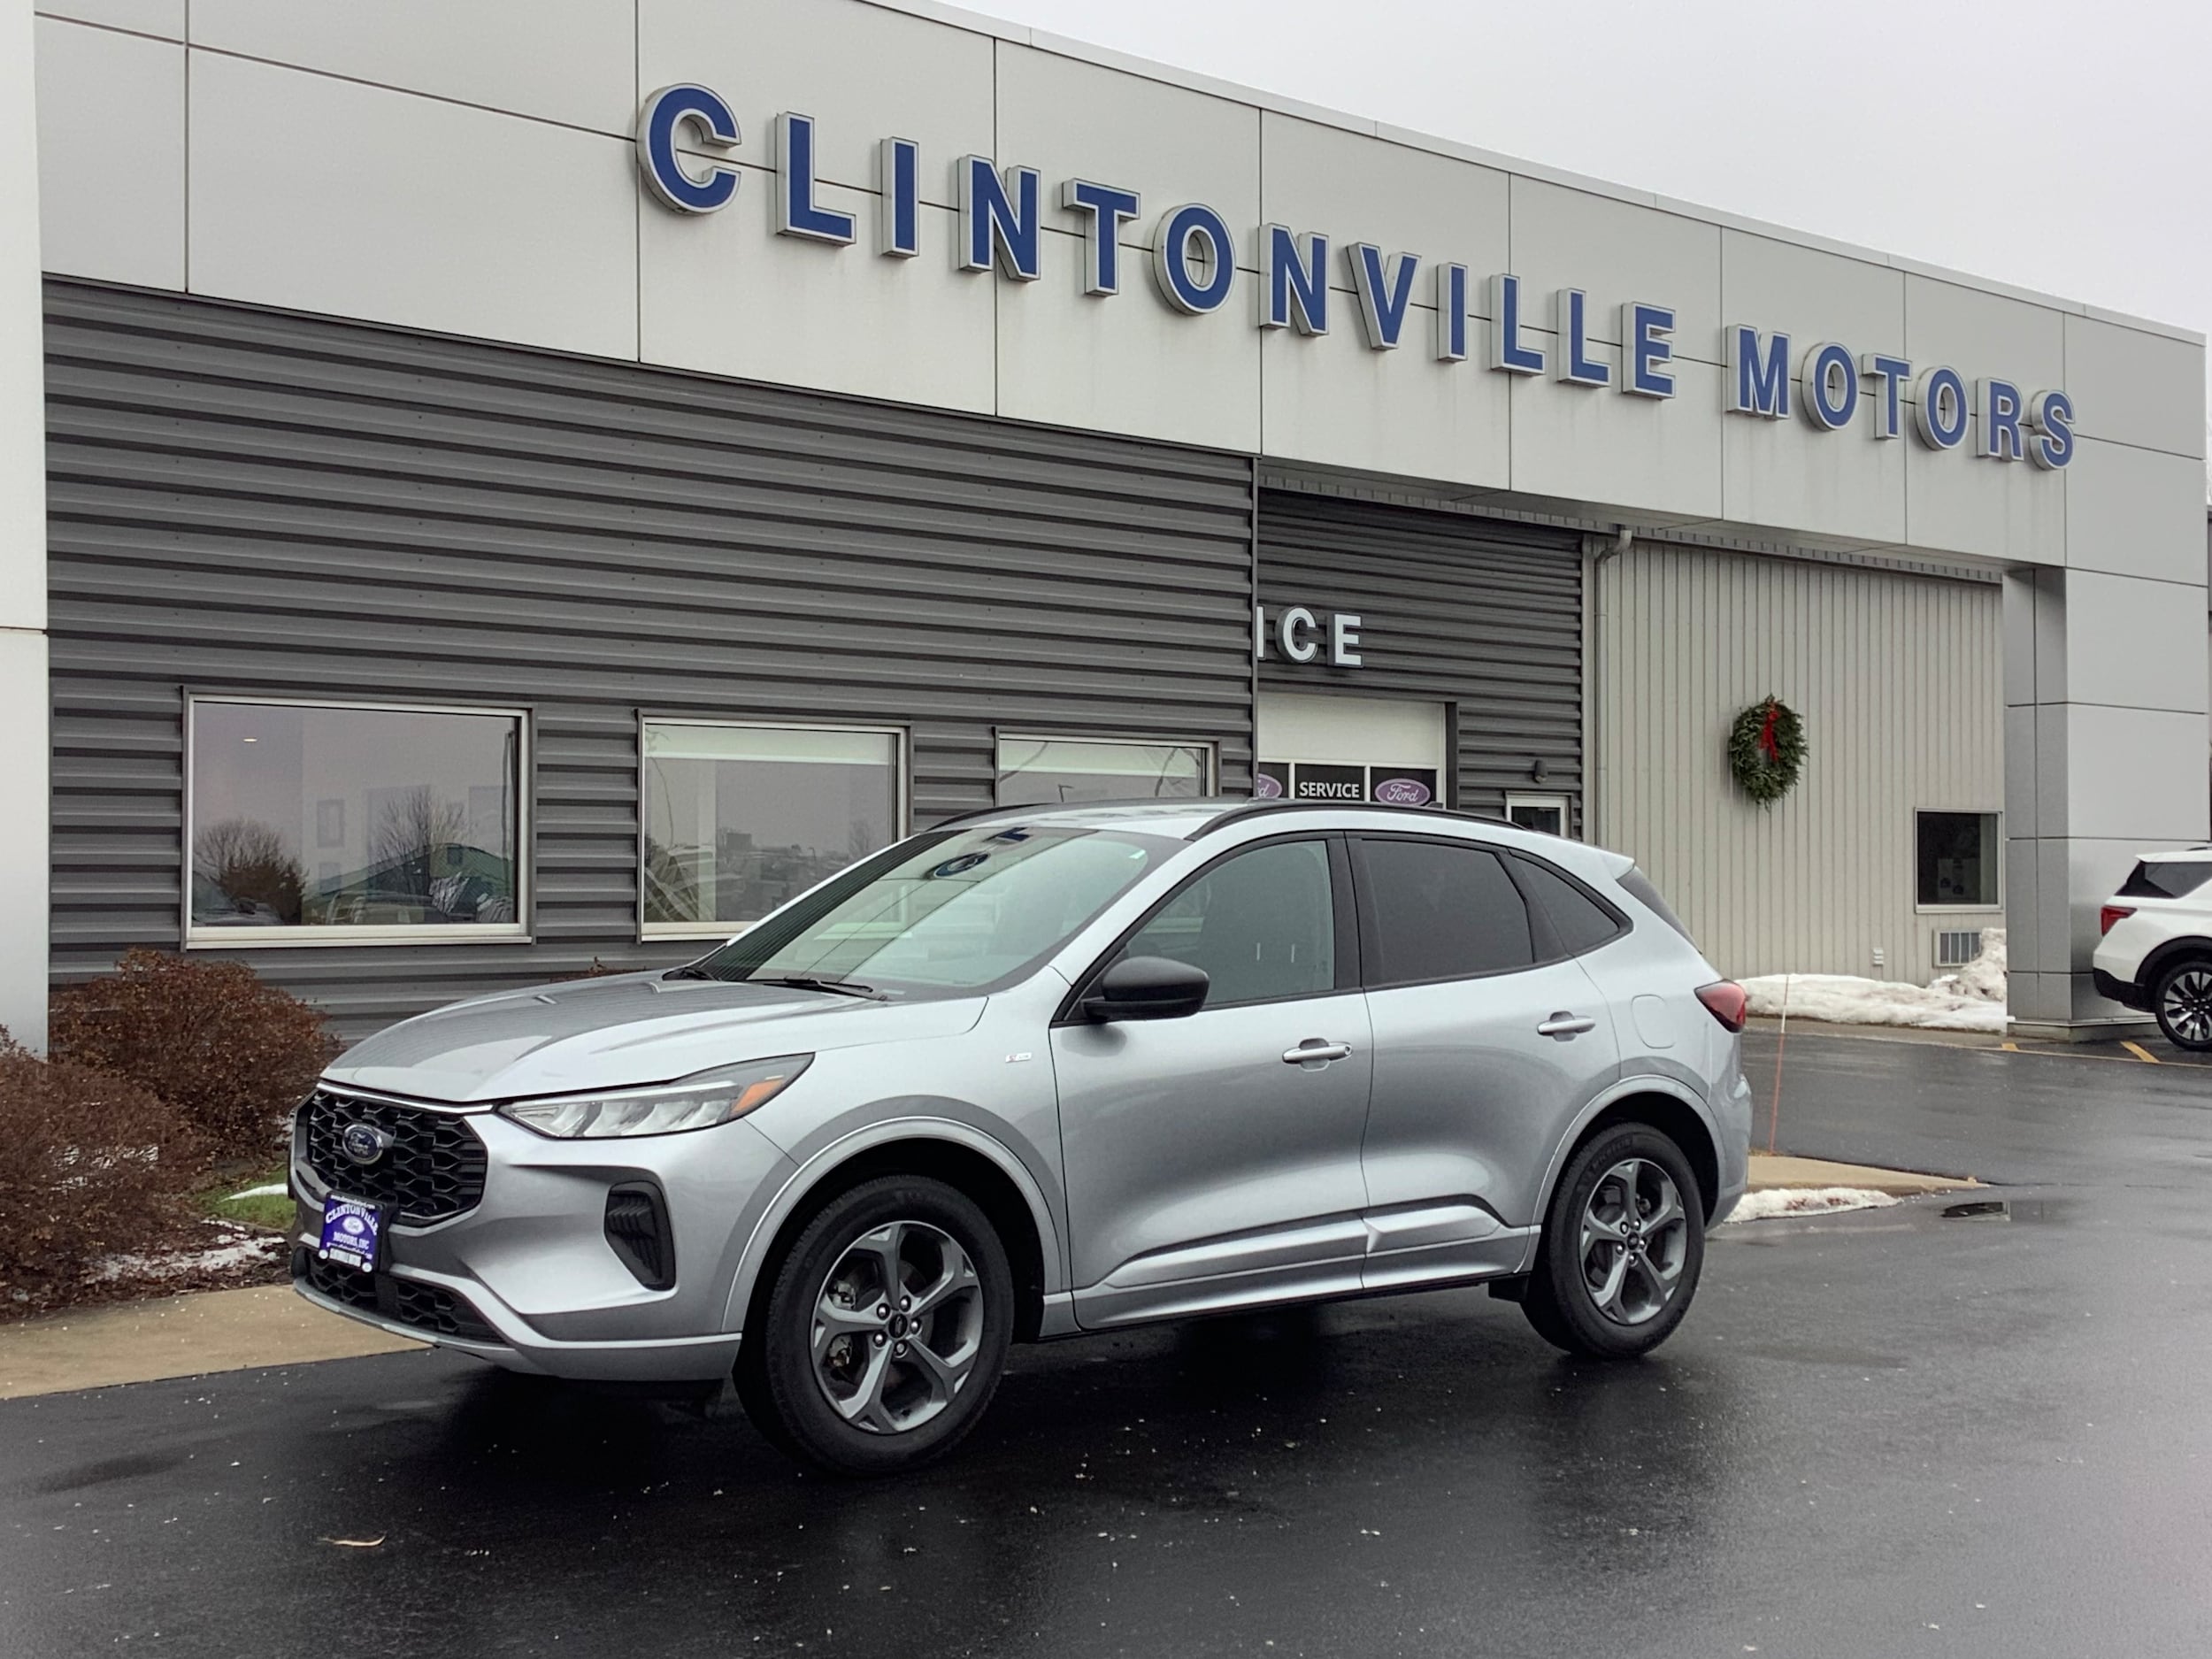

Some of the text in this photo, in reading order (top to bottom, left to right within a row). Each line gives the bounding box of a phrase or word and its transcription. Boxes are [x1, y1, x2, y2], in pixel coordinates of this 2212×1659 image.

[636, 82, 2075, 470] CLINTONVILLE MOTORS
[1299, 781, 1360, 798] SERVICE
[1386, 783, 1419, 802] Ford
[326, 1203, 378, 1235] CLINTONVILLE
